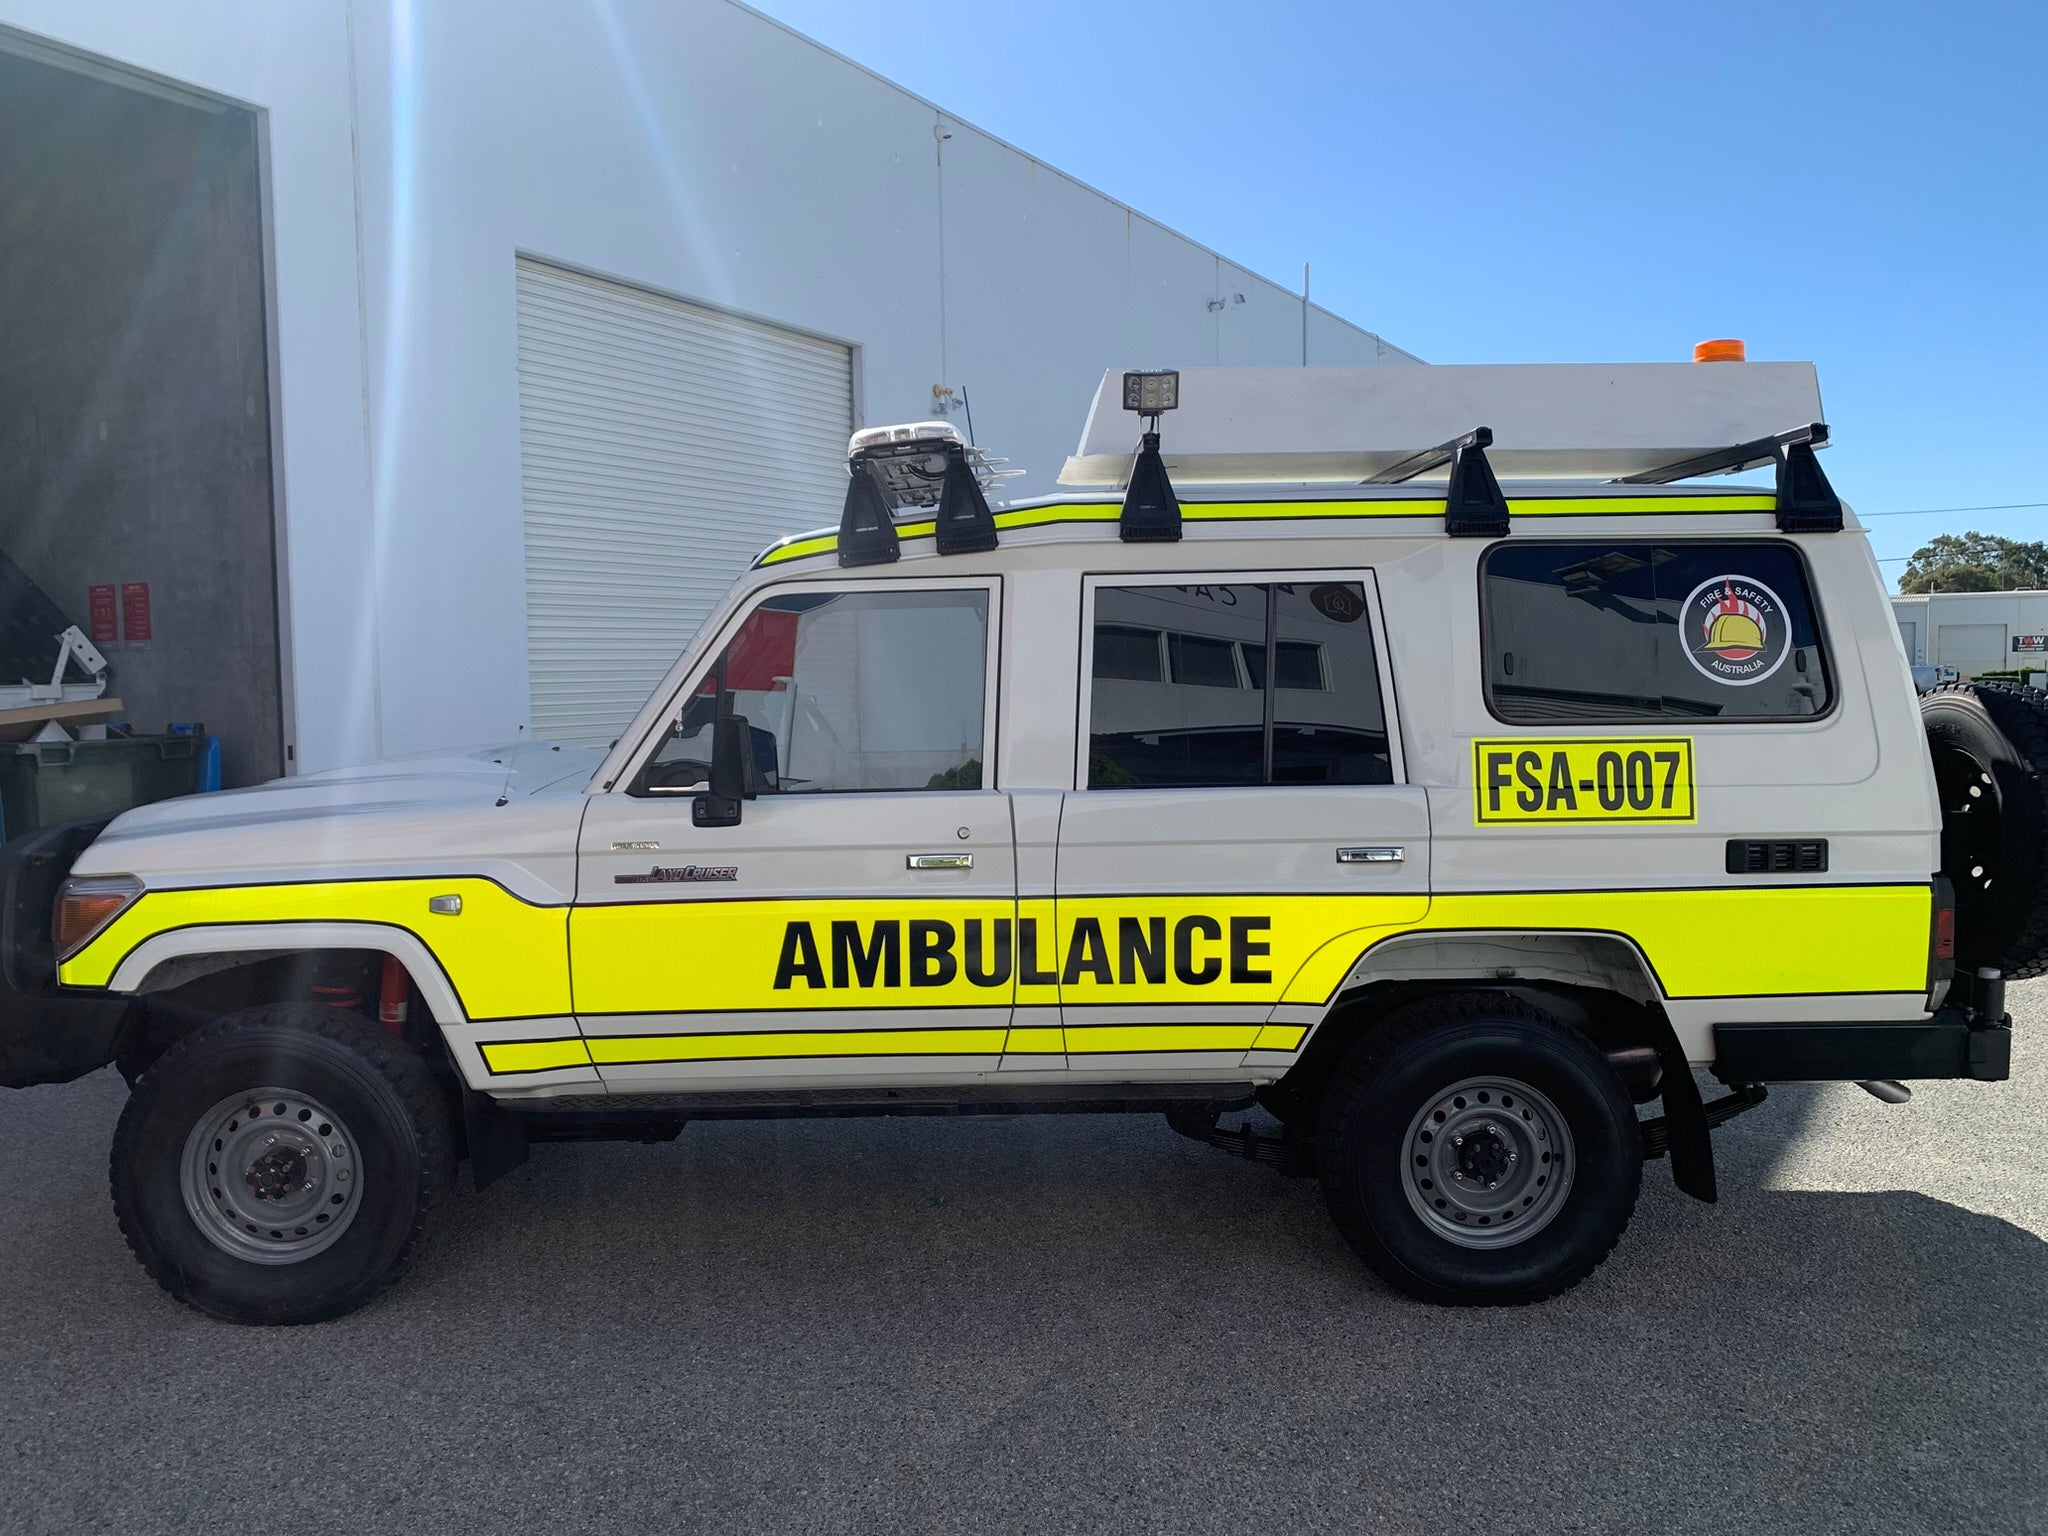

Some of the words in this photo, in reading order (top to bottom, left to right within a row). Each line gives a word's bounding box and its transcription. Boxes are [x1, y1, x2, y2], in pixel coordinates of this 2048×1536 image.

[1700, 589, 1722, 608] FIRE
[1724, 586, 1731, 596] &
[1735, 586, 1773, 613] SAFETY
[1711, 659, 1765, 675] AUSTRALIA
[1487, 750, 1681, 812] FSA-007
[773, 915, 1273, 989] AMBULANCE
